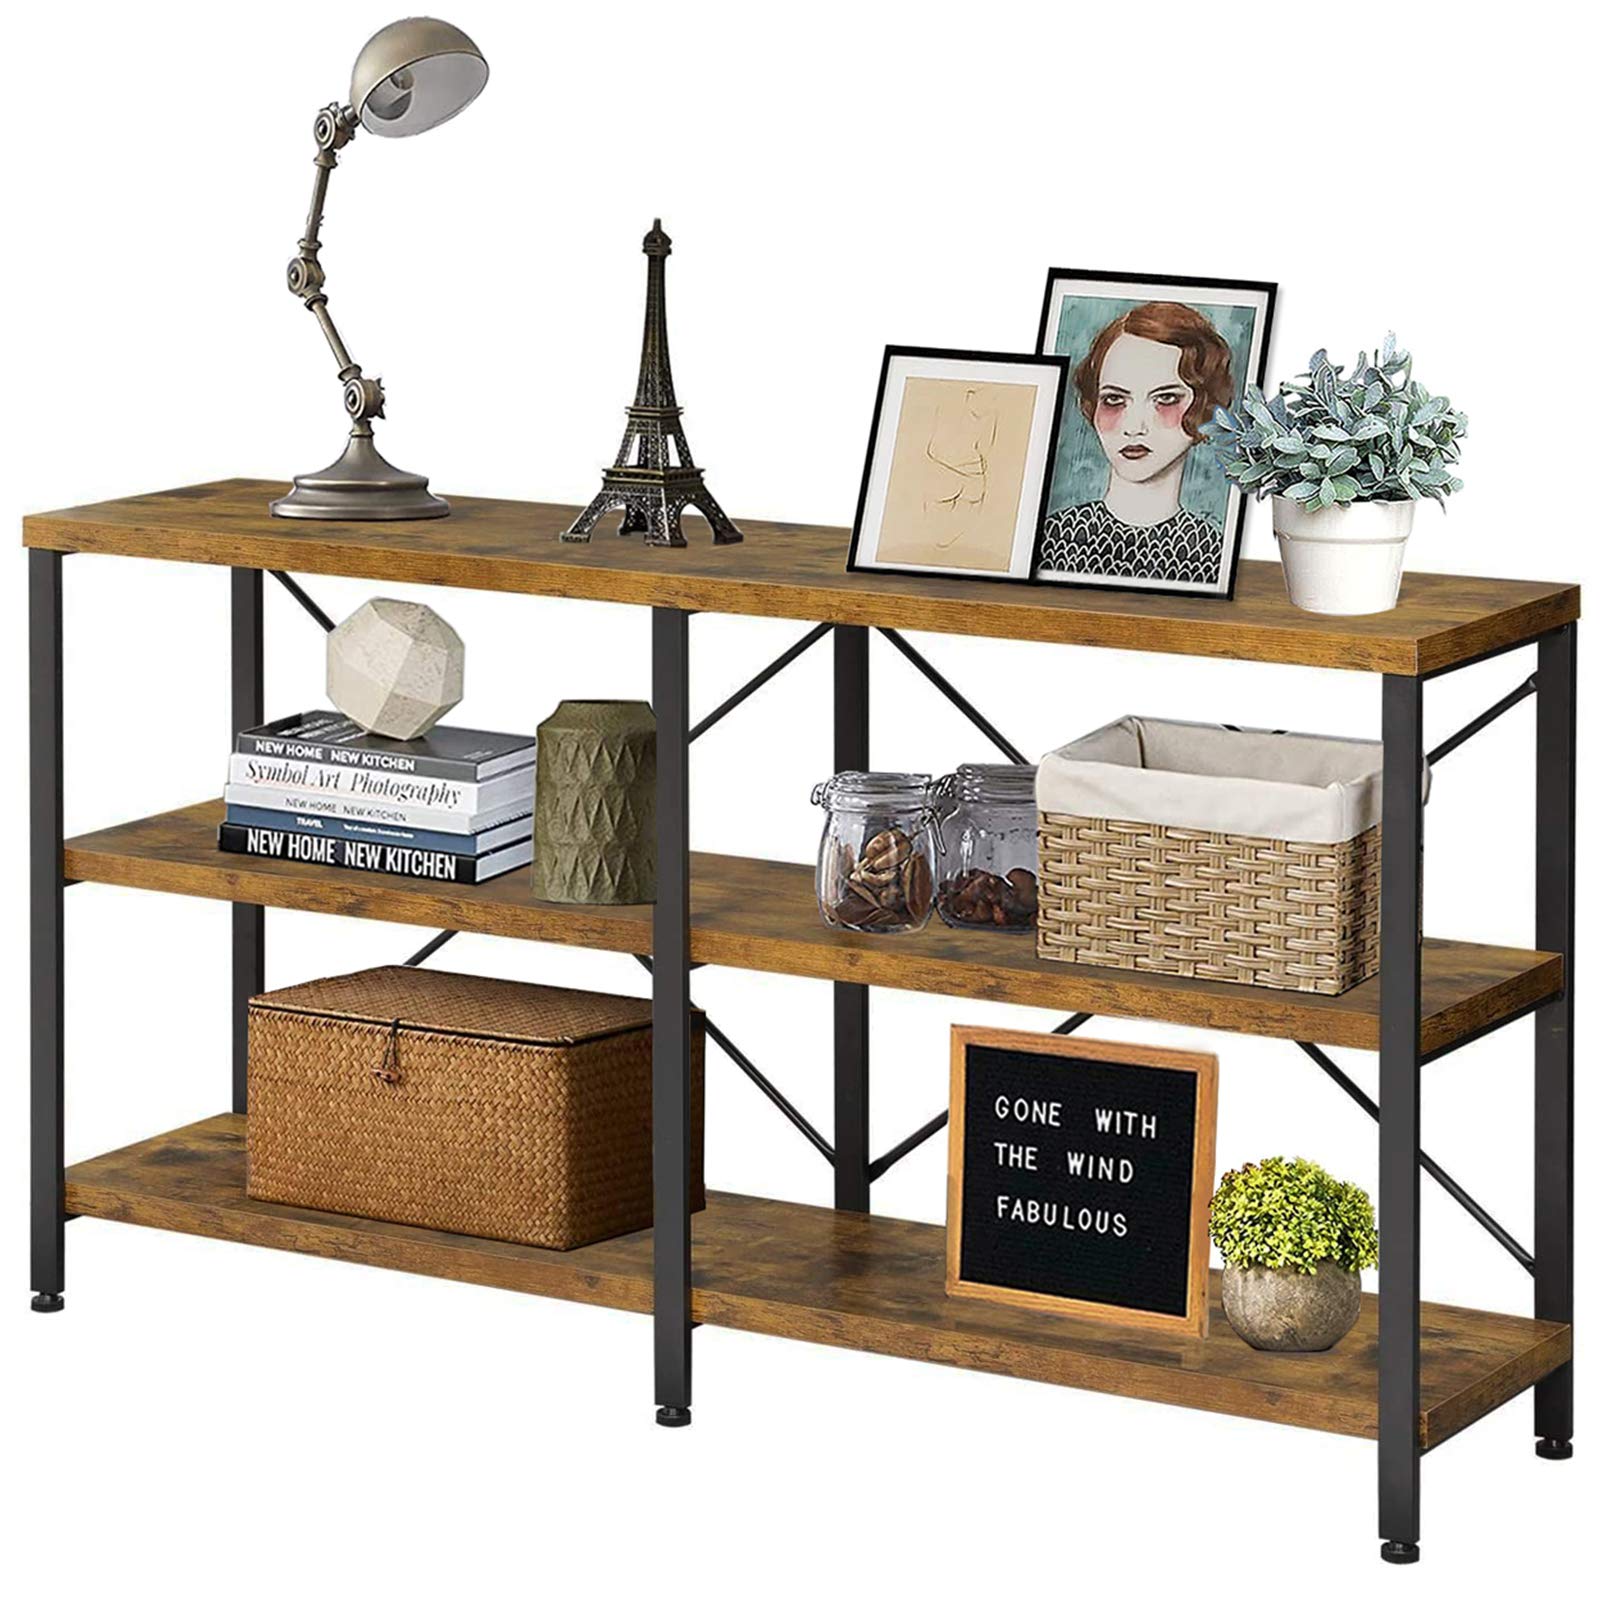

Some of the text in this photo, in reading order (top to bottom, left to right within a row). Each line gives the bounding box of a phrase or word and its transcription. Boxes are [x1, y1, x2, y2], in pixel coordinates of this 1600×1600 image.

[256, 741, 415, 772] NEW HOME NEW KITCHEN
[245, 759, 461, 809] Symbol Art Photography
[285, 797, 407, 822] NEW HOME NEW KITCHEN
[247, 829, 456, 880] NEW HOME NEW KITCHEN
[994, 1095, 1158, 1139] GONE WITH
[993, 1142, 1134, 1184] THE WIND
[996, 1196, 1128, 1238] FABULOUS
